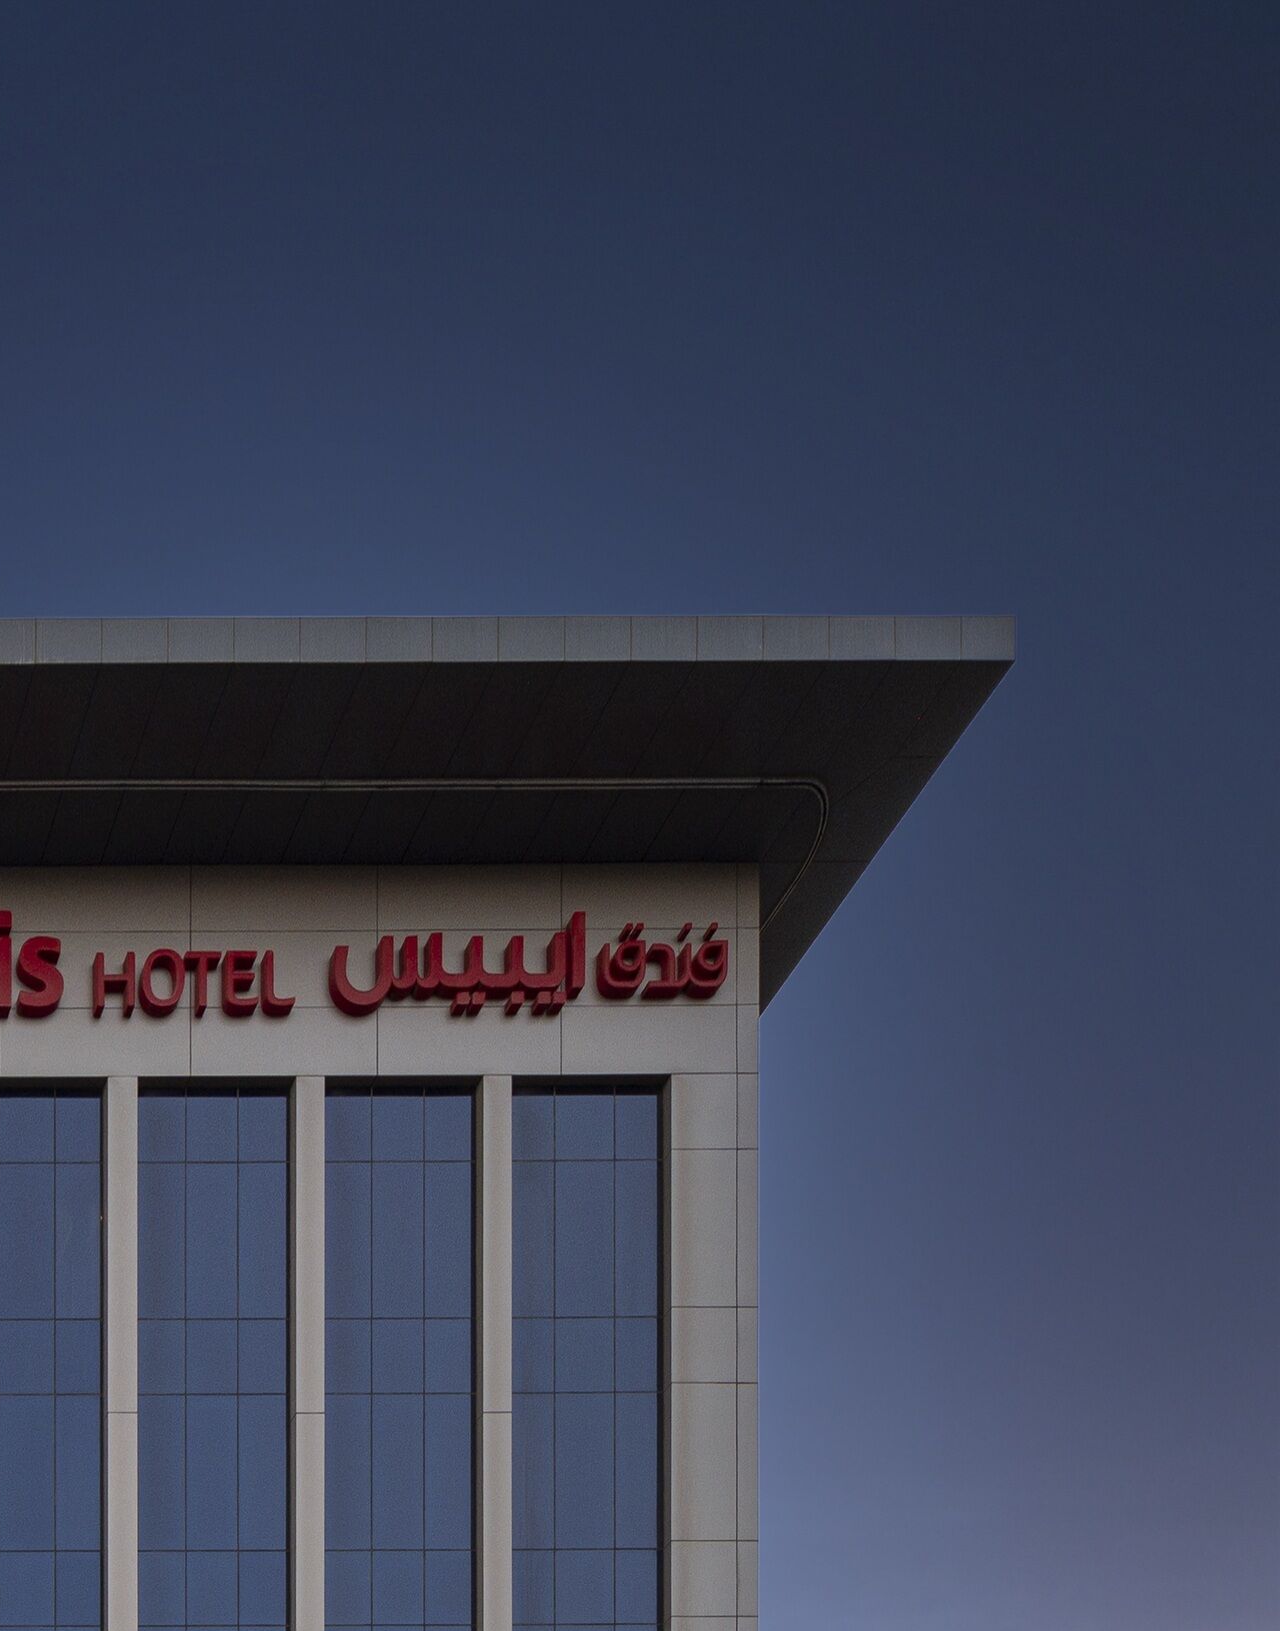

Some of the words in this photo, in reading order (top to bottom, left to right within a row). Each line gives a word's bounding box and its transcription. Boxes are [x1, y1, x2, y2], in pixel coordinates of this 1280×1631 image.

[92, 948, 296, 1019] HOTEL
[328, 911, 586, 1017] ايبيس
[595, 921, 728, 999] فندق
